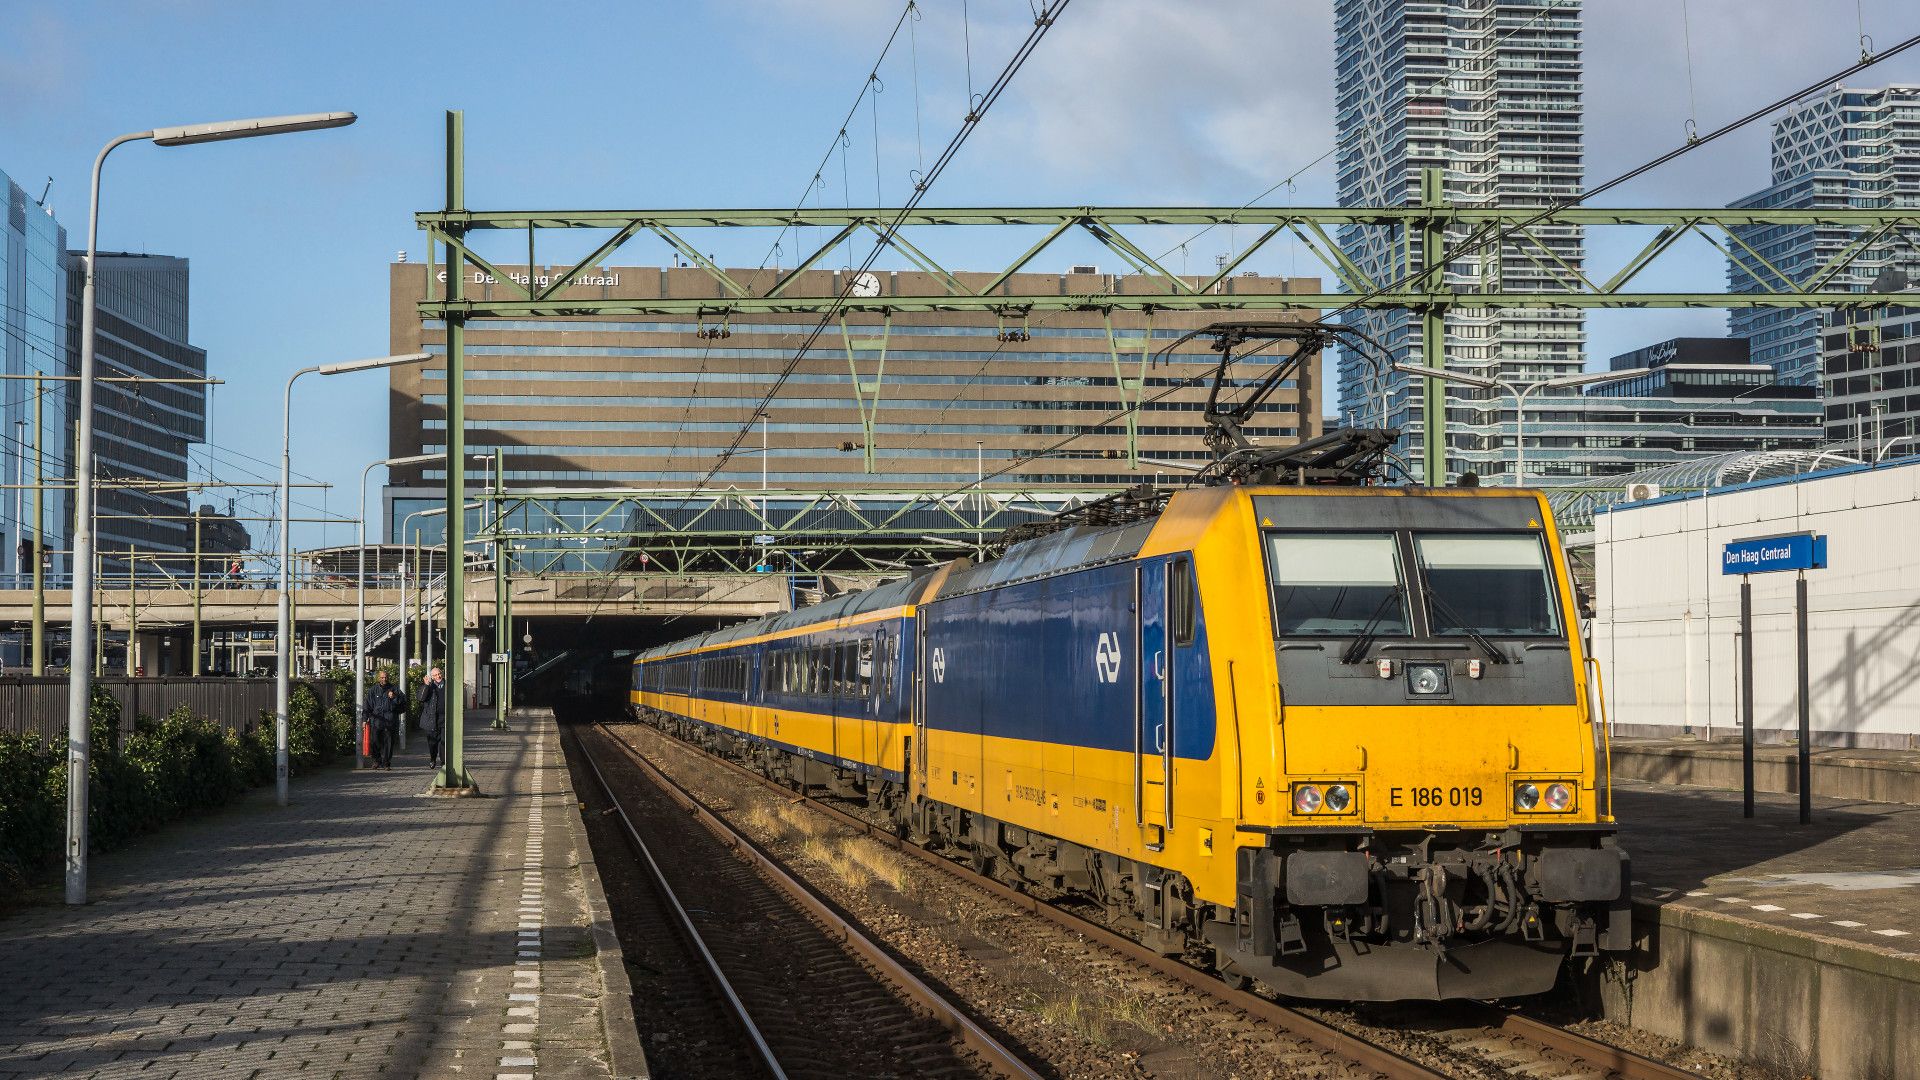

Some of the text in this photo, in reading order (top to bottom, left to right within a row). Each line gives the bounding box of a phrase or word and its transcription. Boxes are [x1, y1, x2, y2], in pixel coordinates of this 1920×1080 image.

[474, 272, 500, 284] De
[554, 273, 620, 287] ntraal
[1726, 544, 1791, 565] Den Haag Centraal
[468, 643, 474, 652] 1
[1390, 787, 1483, 807] E 186 019
